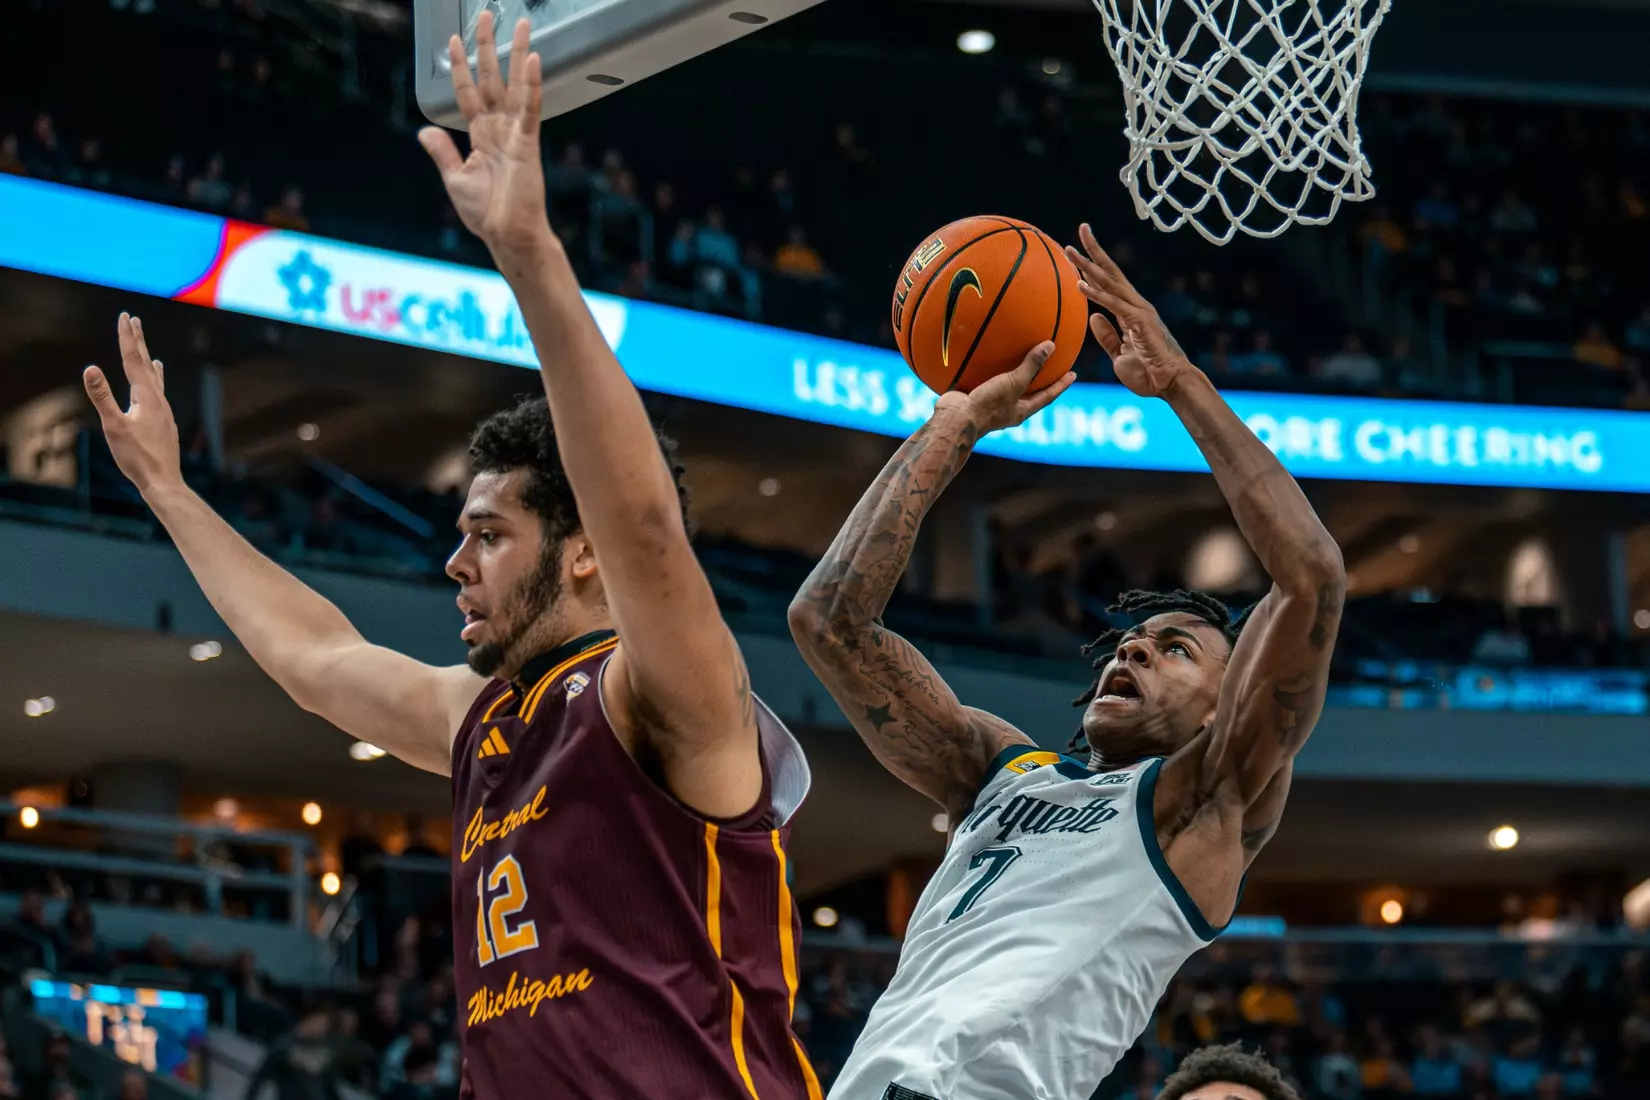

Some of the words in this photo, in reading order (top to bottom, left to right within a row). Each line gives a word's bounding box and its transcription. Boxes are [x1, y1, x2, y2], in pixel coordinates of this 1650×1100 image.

[893, 236, 947, 333] ELITE
[793, 358, 889, 416] LESS
[1236, 411, 1345, 462] ORE
[1353, 418, 1603, 474] CHEERING
[477, 853, 540, 968] 12
[945, 845, 1023, 925] 7
[467, 967, 594, 1027] Michigan
